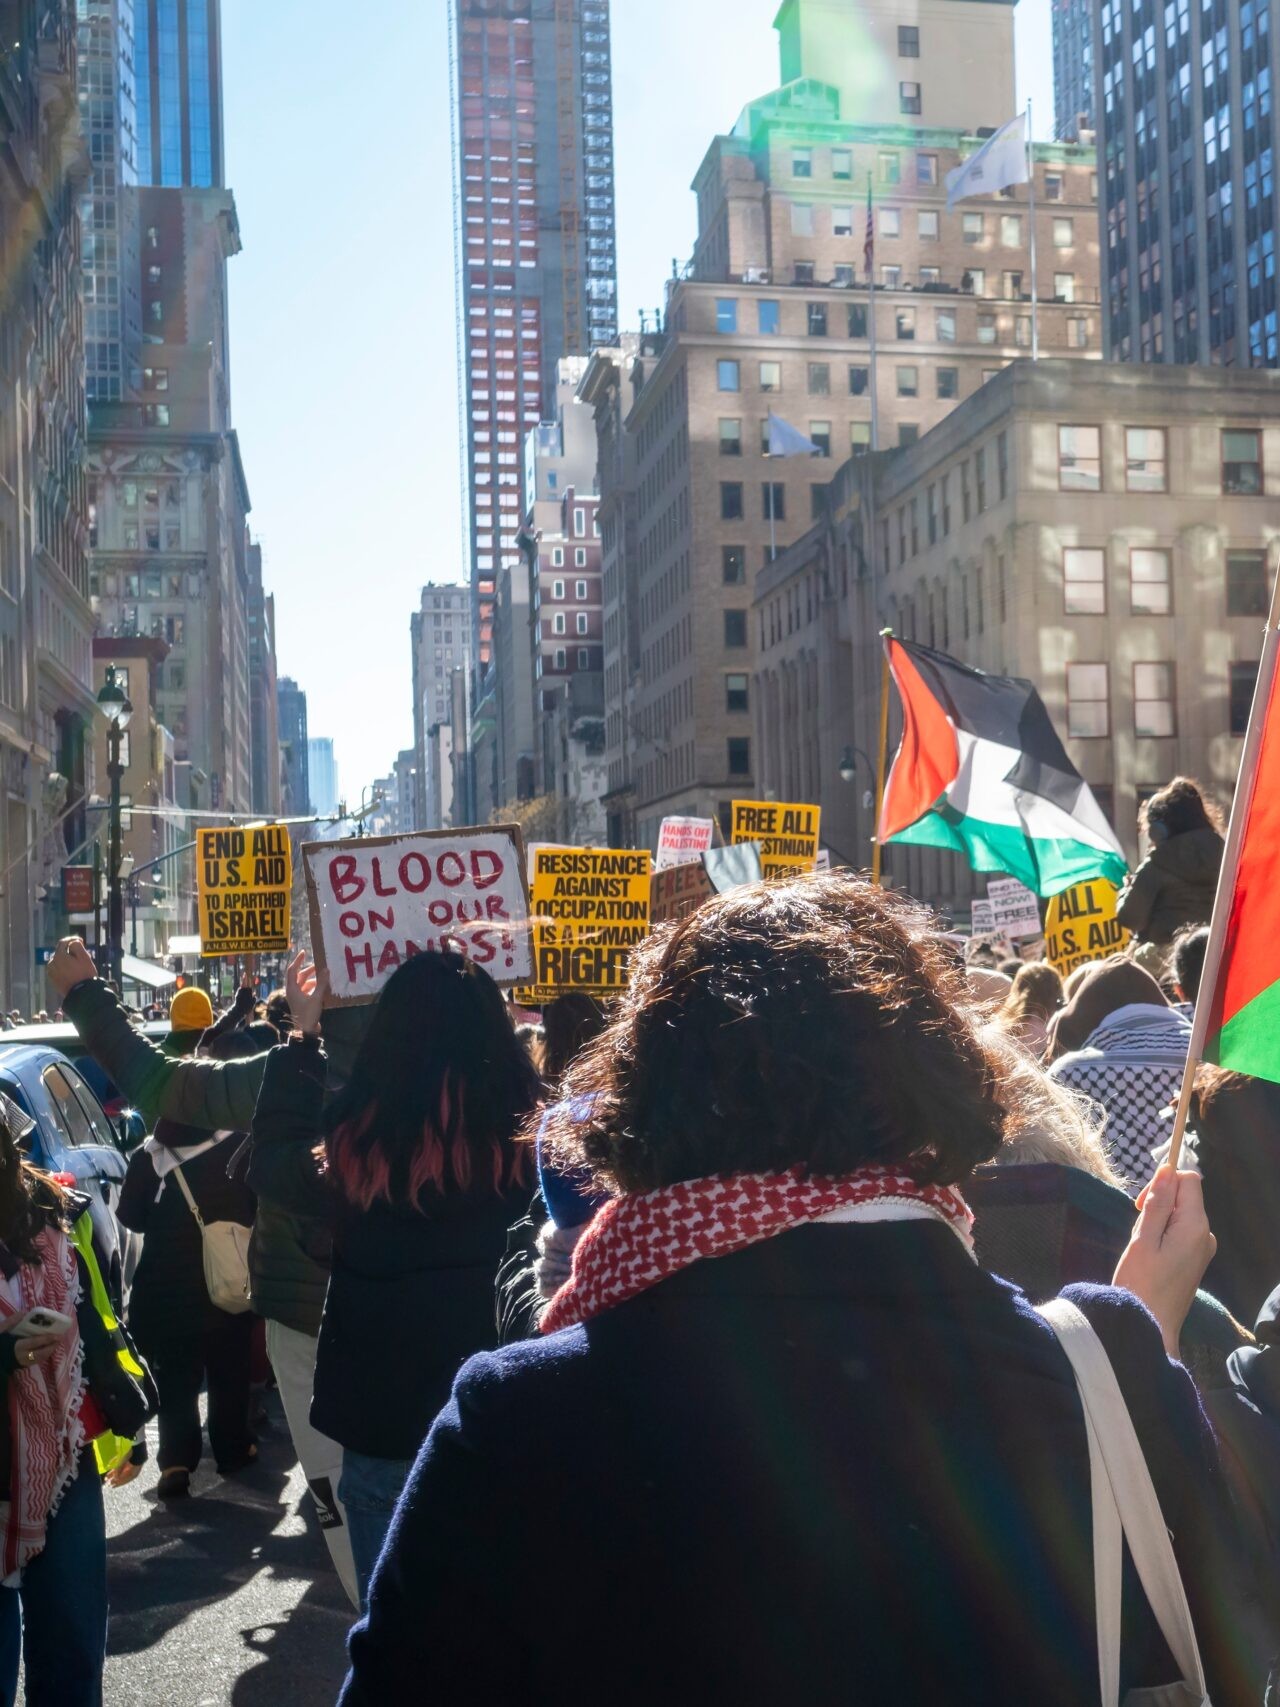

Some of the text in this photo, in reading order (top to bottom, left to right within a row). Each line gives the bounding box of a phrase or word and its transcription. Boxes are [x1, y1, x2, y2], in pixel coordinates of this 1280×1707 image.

[663, 823, 710, 838] HANDS OFF
[736, 806, 816, 836] FREE ALL
[203, 828, 286, 859] END ALL
[736, 835, 815, 857] ESTINIAN
[204, 858, 286, 888] U.S. AID
[329, 850, 504, 904] BLOOD
[538, 854, 647, 875] RESISTANCE
[553, 877, 631, 897] AGAINST
[205, 891, 286, 910] TO APARTHEID
[536, 900, 647, 920] OCCUPATION
[994, 905, 1036, 922] FREE
[1058, 885, 1103, 923] ALL
[208, 909, 285, 939] ISRAEL!
[339, 895, 509, 938] ON OUR
[539, 925, 646, 946] IS A HUMAN
[1048, 917, 1123, 962] U.S. AID
